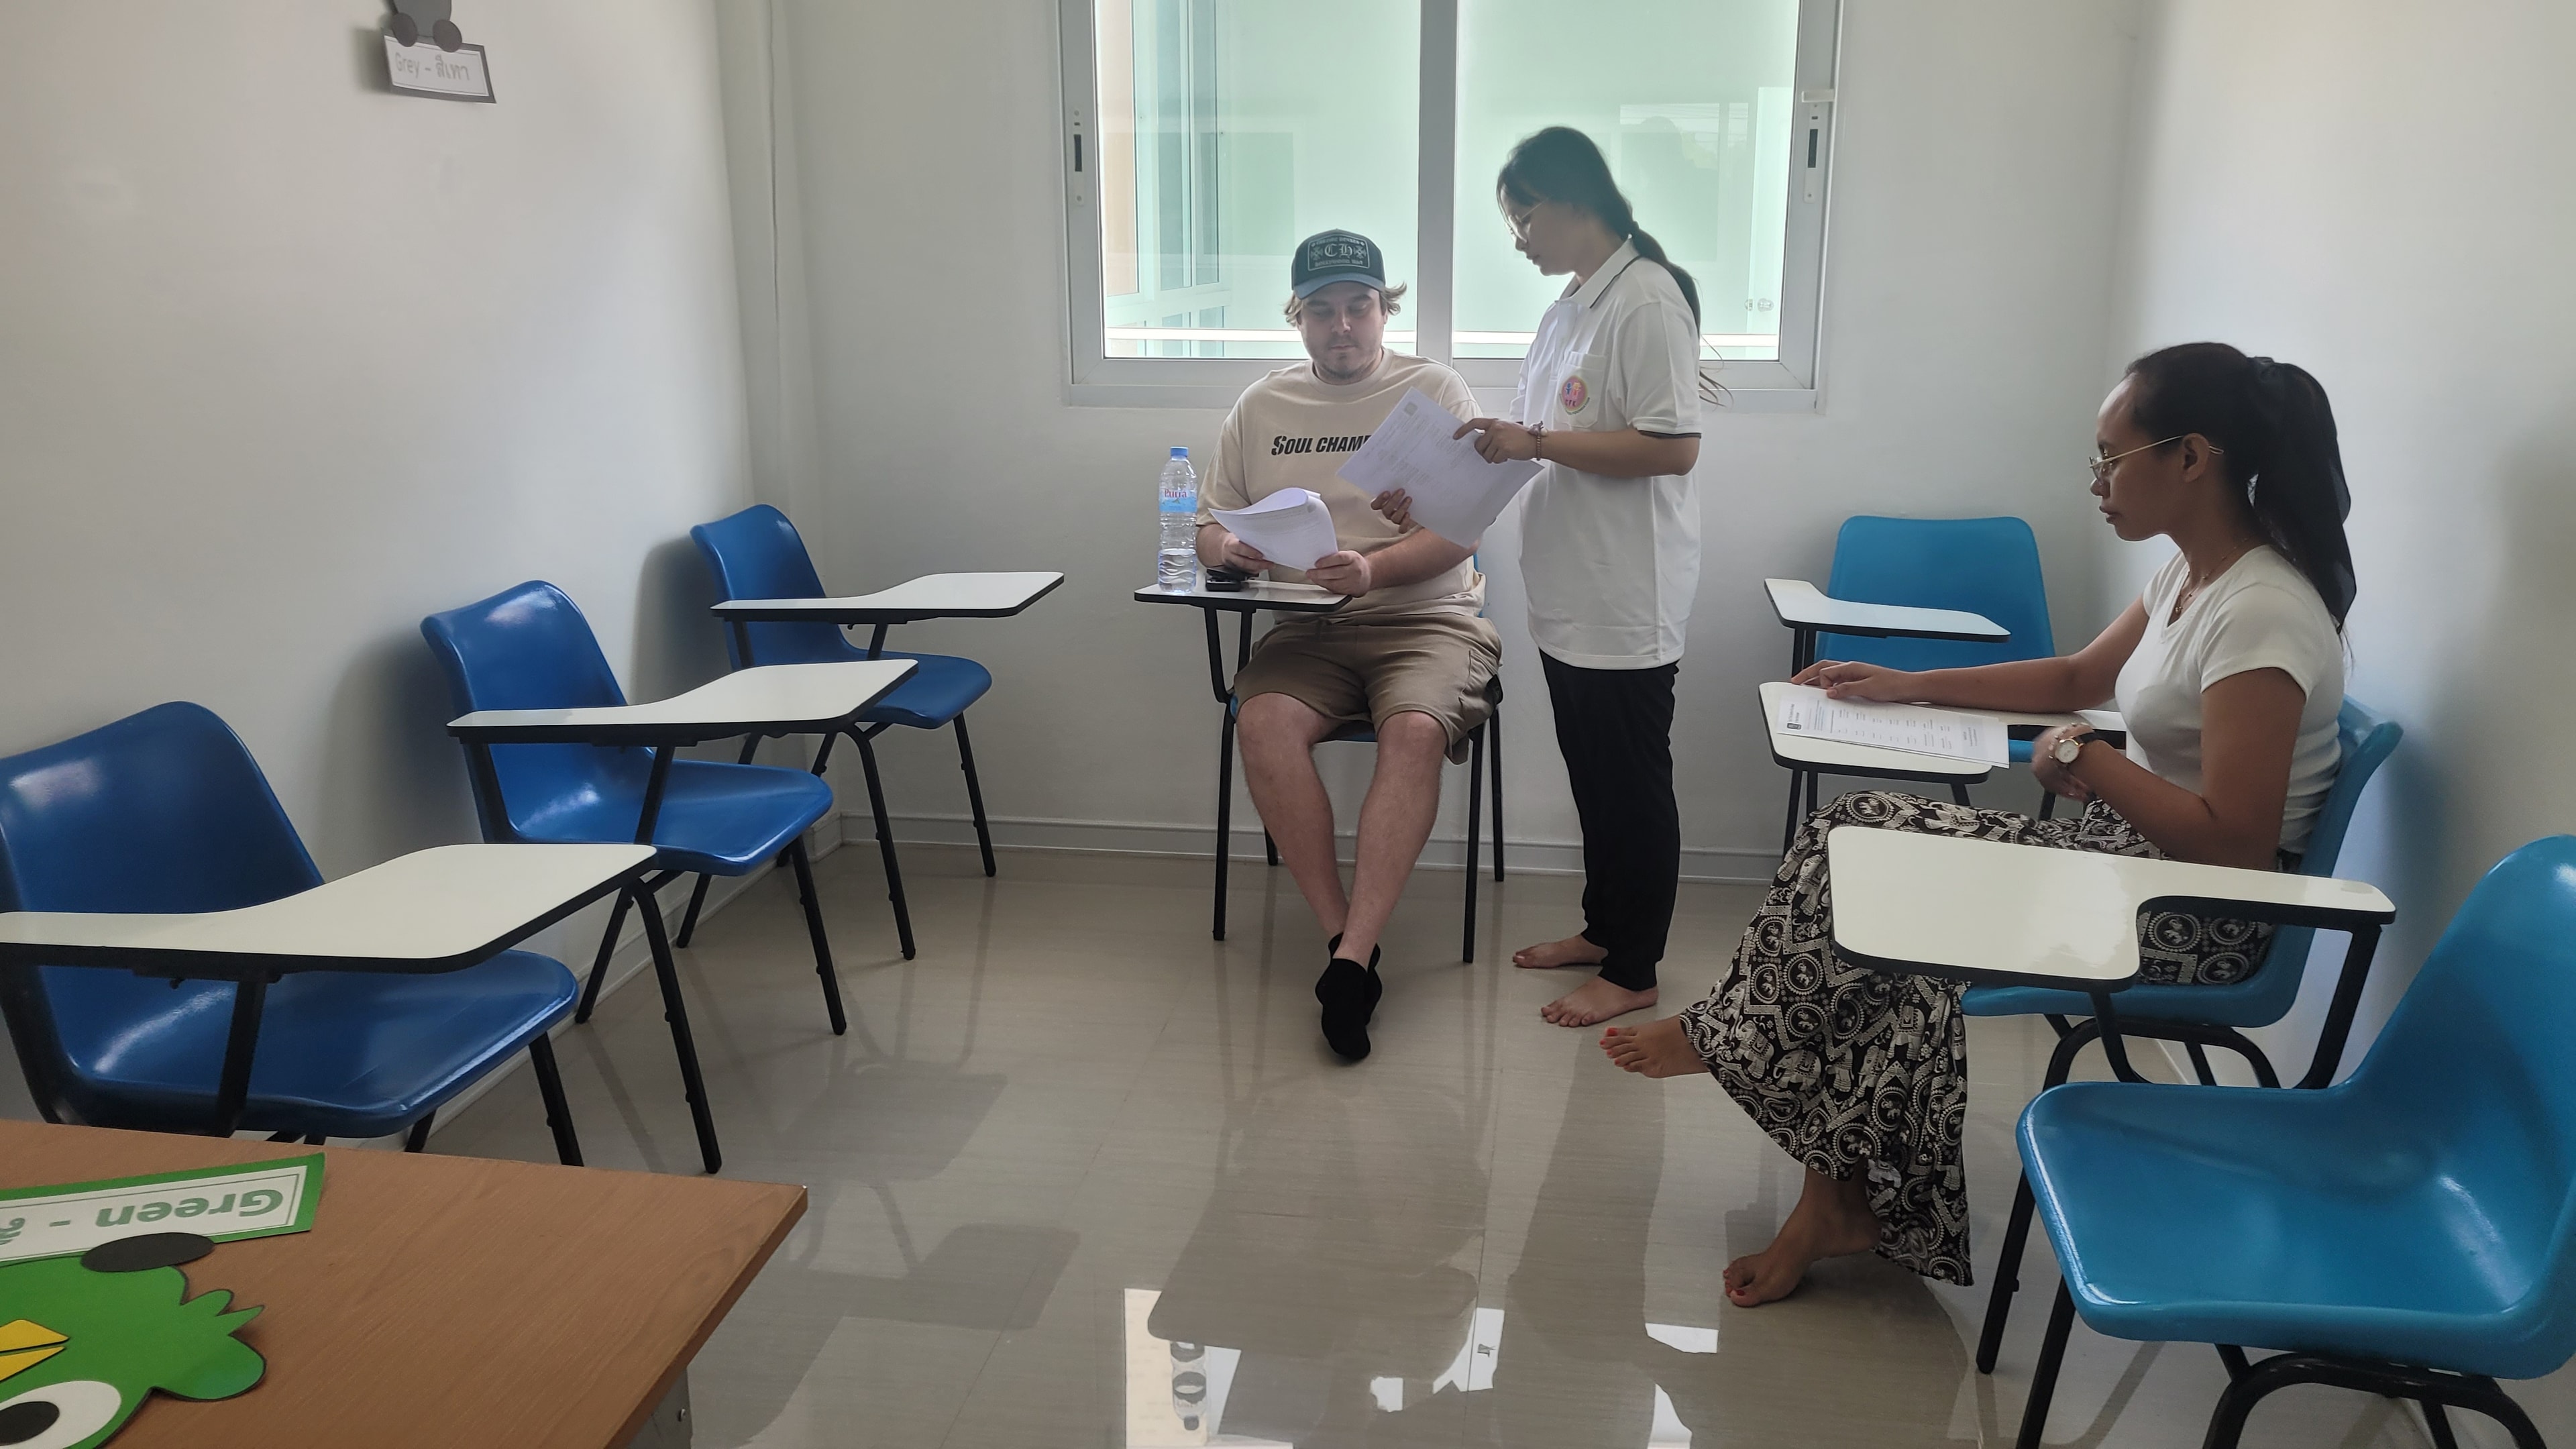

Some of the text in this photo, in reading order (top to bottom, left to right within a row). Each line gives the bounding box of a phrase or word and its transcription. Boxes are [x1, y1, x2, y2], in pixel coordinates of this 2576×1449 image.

[394, 52, 419, 78] Grey
[435, 54, 470, 80] สีเทา
[1271, 436, 1313, 455] SOUL
[95, 1189, 283, 1228] Green
